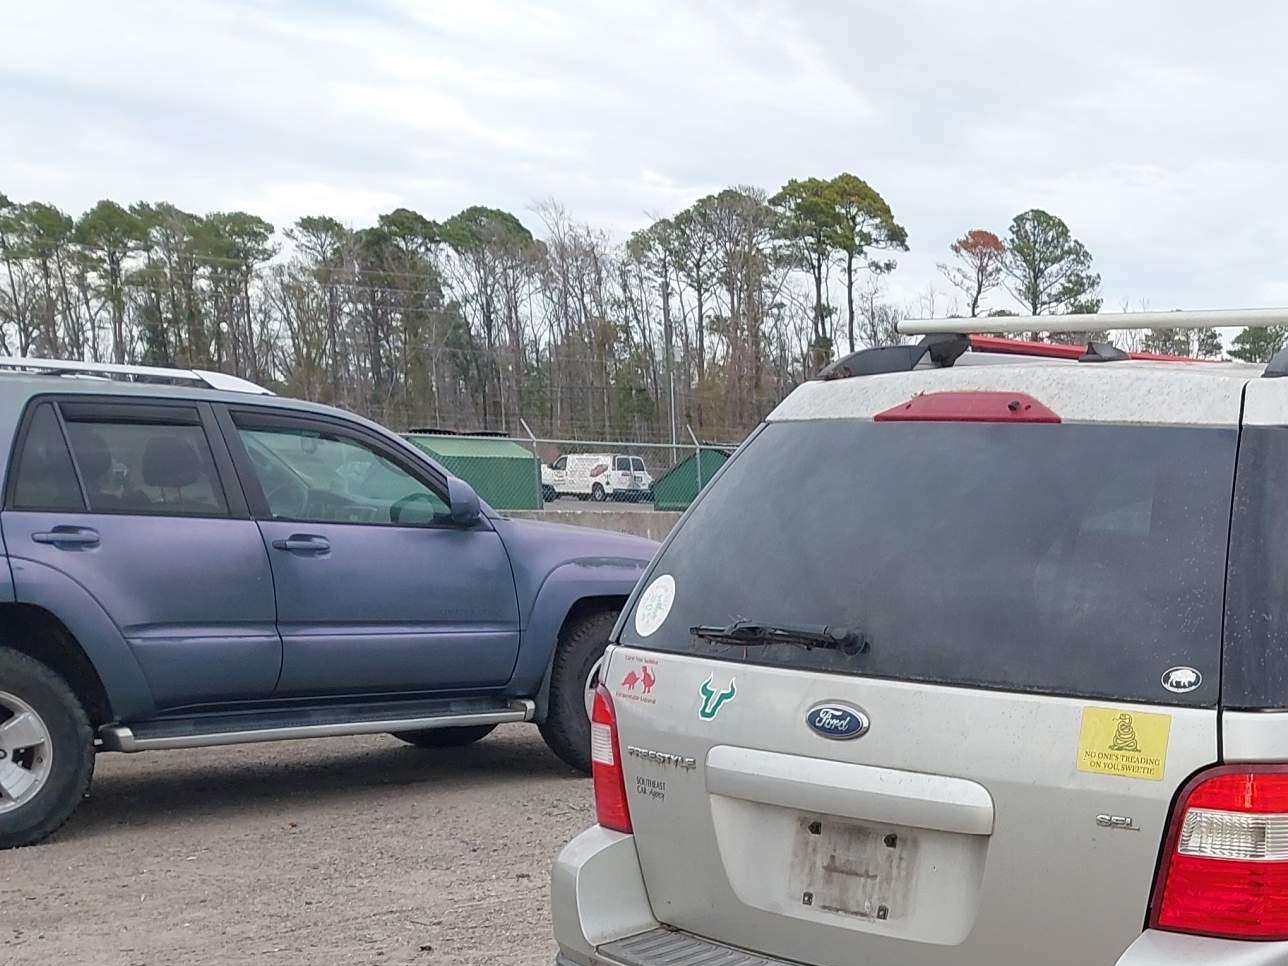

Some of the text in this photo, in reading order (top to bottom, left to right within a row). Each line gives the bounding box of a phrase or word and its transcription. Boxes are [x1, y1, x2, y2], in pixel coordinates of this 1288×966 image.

[815, 708, 850, 731] Ford
[627, 745, 697, 771] FREESTYLE
[1084, 751, 1161, 767] NO ONE'S TREADING
[1090, 760, 1102, 769] ON
[1096, 813, 1140, 831] SEL
